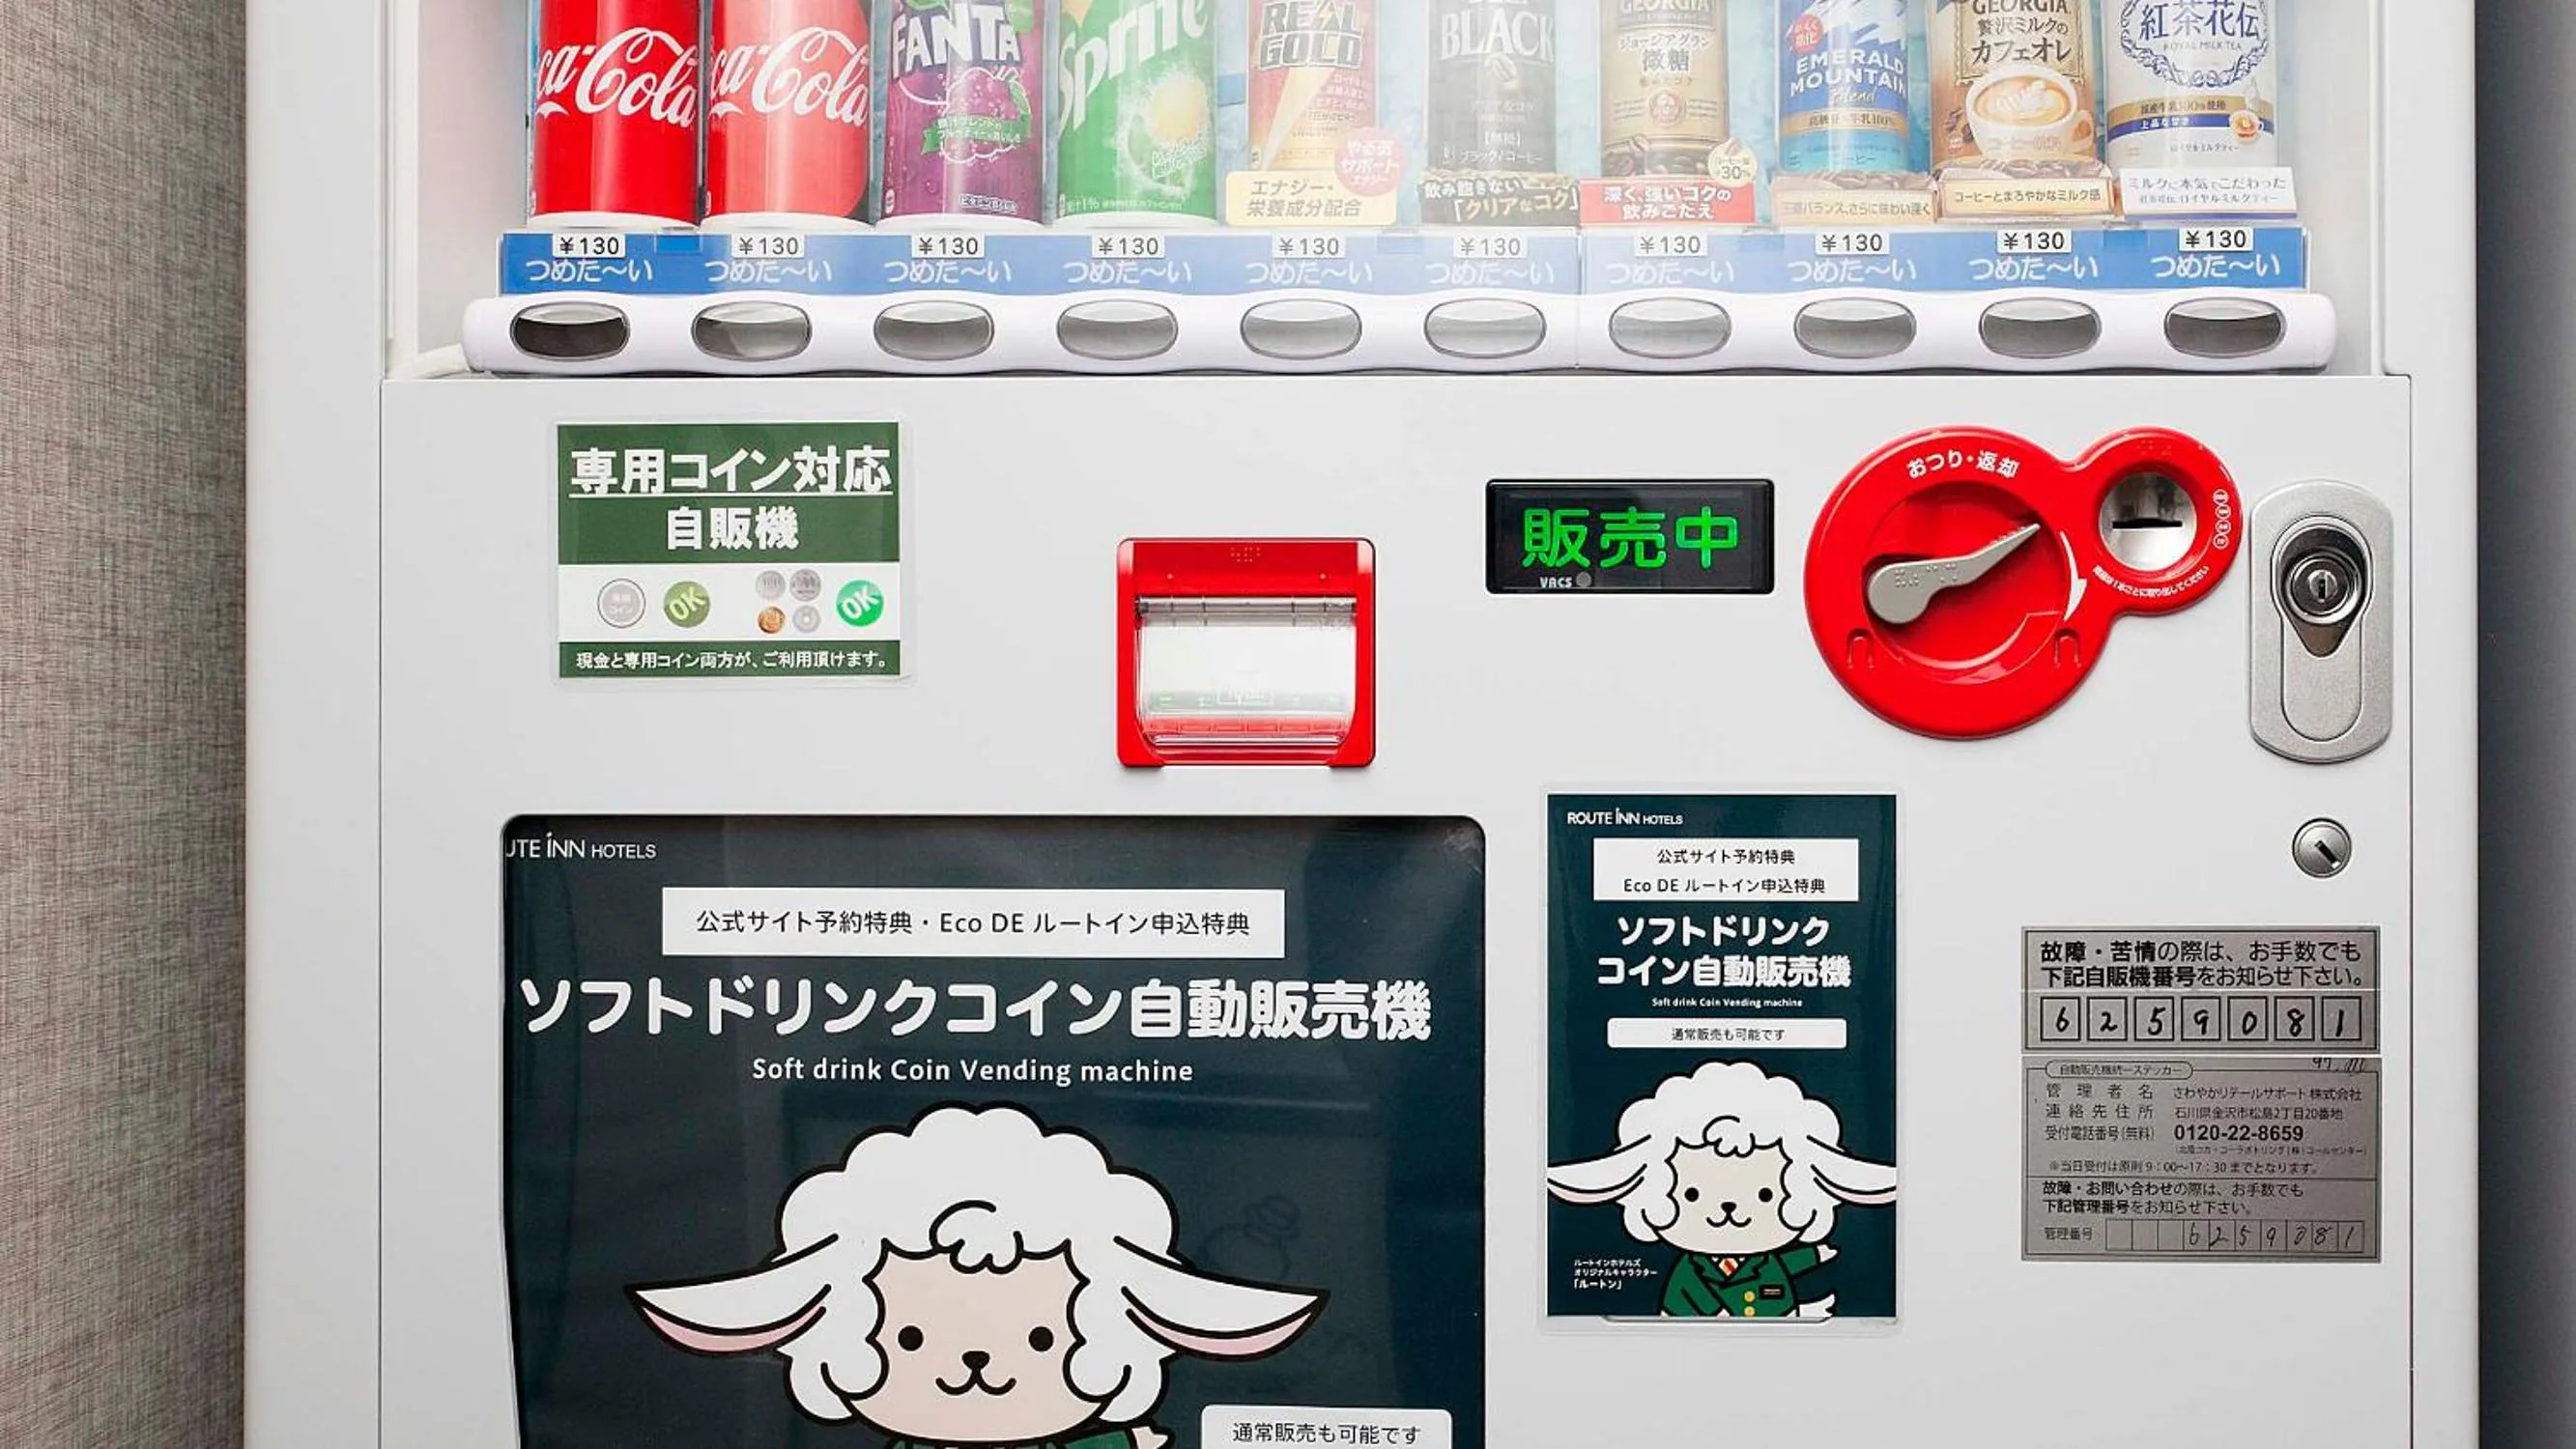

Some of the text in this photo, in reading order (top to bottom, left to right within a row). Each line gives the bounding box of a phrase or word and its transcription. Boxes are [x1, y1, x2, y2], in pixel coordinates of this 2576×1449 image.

[2139, 0, 2261, 41] 紅茶花伝
[892, 2, 1021, 79] FANTA
[1971, 37, 2072, 66] カフェオレ
[1796, 48, 1904, 75] EMERALD
[1423, 177, 1520, 199] 飲み飽きない
[1603, 185, 1732, 204] 深く、強いコクの
[1954, 187, 2102, 203] コーヒーとまろやかなミルク感
[1246, 198, 1363, 218] 栄養成分配合
[1454, 185, 1579, 222] 「クリアなコク」
[1621, 203, 1714, 220] 飲みごたえ
[570, 444, 892, 495] 専用コイン対応
[1905, 448, 2020, 480] おつり・返却
[667, 506, 800, 550] 自販機
[1522, 505, 1738, 569] 販売中
[1539, 576, 1573, 588] VACS
[667, 583, 706, 621] OK
[840, 582, 880, 620] OK
[576, 650, 887, 669] 現金と専用コイン両方が、ご利用頂けます。
[1566, 811, 1613, 825] ROUTE
[1643, 814, 1683, 825] HOTELS
[590, 843, 656, 860] HOTELS
[1657, 848, 1796, 866] 公式サイト予約特典
[1623, 878, 1826, 894] Eco DE ルートイン申込特典
[990, 913, 1025, 933] DE
[1033, 911, 1250, 936] ルートイン申込特典
[1617, 914, 1830, 947] ソフトドリンク
[2041, 940, 2362, 963] 故障・苦情の際は、お手数でも
[1597, 954, 1851, 988] コイン自動販売機
[2041, 966, 2363, 989] 下記自販機番号をお知らせ下さい。
[520, 976, 1432, 1042] ソフトドリンクコイン自動販売機
[1651, 997, 1803, 1009] Soft drink Coin Vending machine
[1671, 1028, 1786, 1041] 通常販売も可能です
[752, 1057, 1194, 1087] Soft drink Coin Vending machine
[2174, 1124, 2304, 1142] 0120-22-8659
[2042, 1180, 2304, 1197] 故障・お問い合わせの際は、お手数でも
[2043, 1199, 2251, 1215] 下記管理番号をお知らせ下さい。
[2044, 1227, 2093, 1240] 管理番号
[1573, 1277, 1622, 1291] 「ルートン」
[1232, 1421, 1421, 1445] 通常販売も可能です
